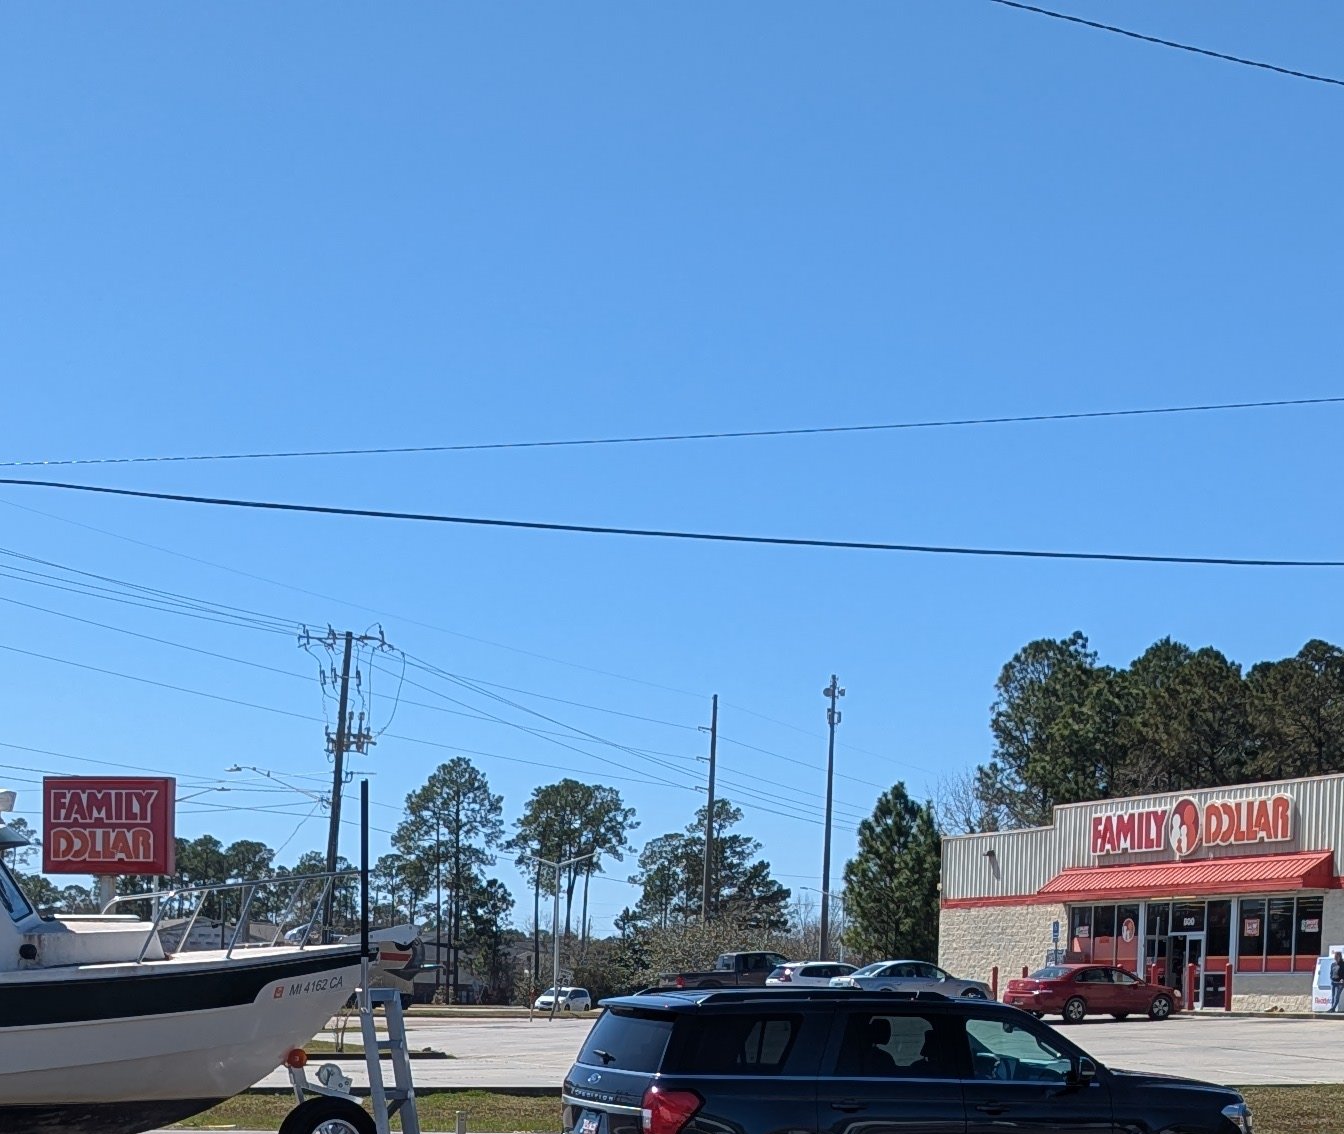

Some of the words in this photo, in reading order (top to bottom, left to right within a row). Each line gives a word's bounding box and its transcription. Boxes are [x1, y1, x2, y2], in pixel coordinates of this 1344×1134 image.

[51, 789, 158, 823] FAMILY
[1091, 808, 1168, 855] FAMILY
[1204, 795, 1291, 846] DOLLAR
[51, 827, 153, 861] DOLLAR
[289, 984, 303, 996] MI
[304, 979, 328, 994] 4162
[330, 976, 343, 988] CA
